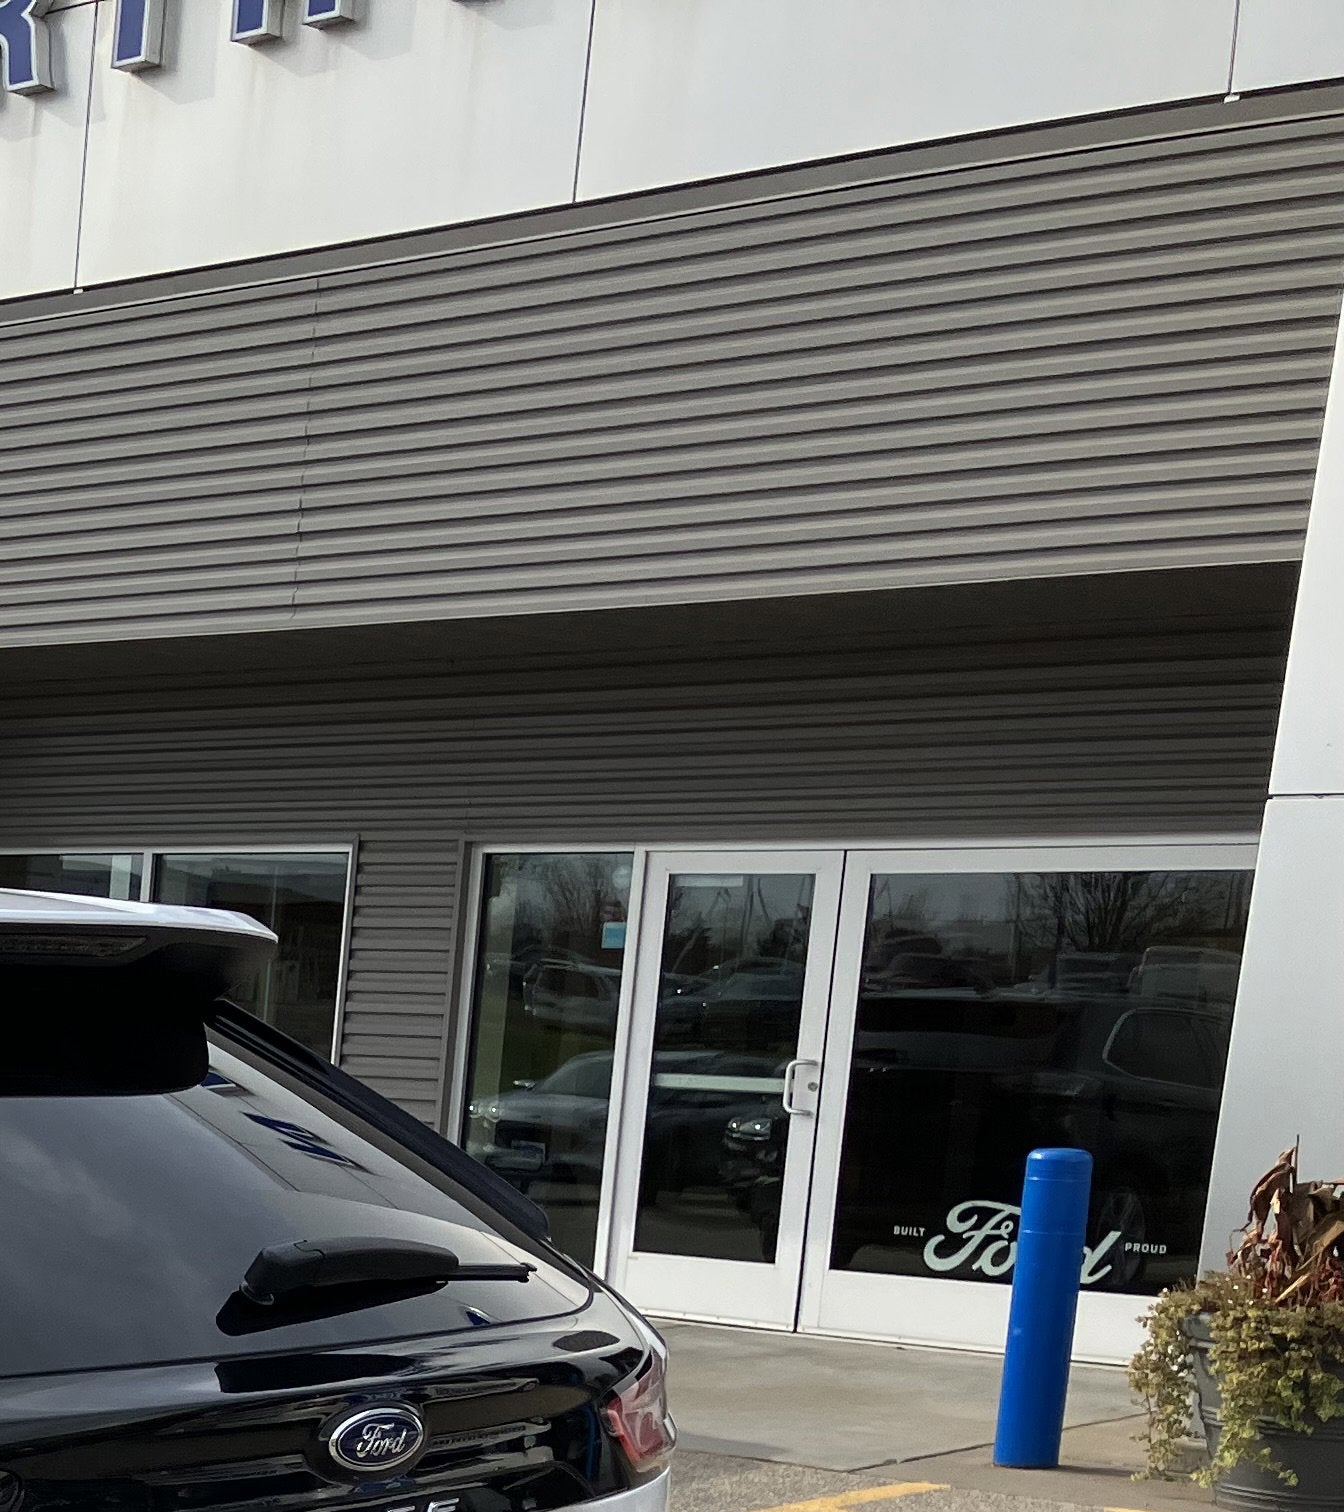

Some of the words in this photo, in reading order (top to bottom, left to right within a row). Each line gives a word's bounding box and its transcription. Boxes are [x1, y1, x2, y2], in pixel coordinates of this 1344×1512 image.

[893, 1225, 925, 1237] BUILT
[923, 1200, 1121, 1284] Fod
[1125, 1242, 1167, 1254] PROUD
[356, 1423, 407, 1457] Ford
